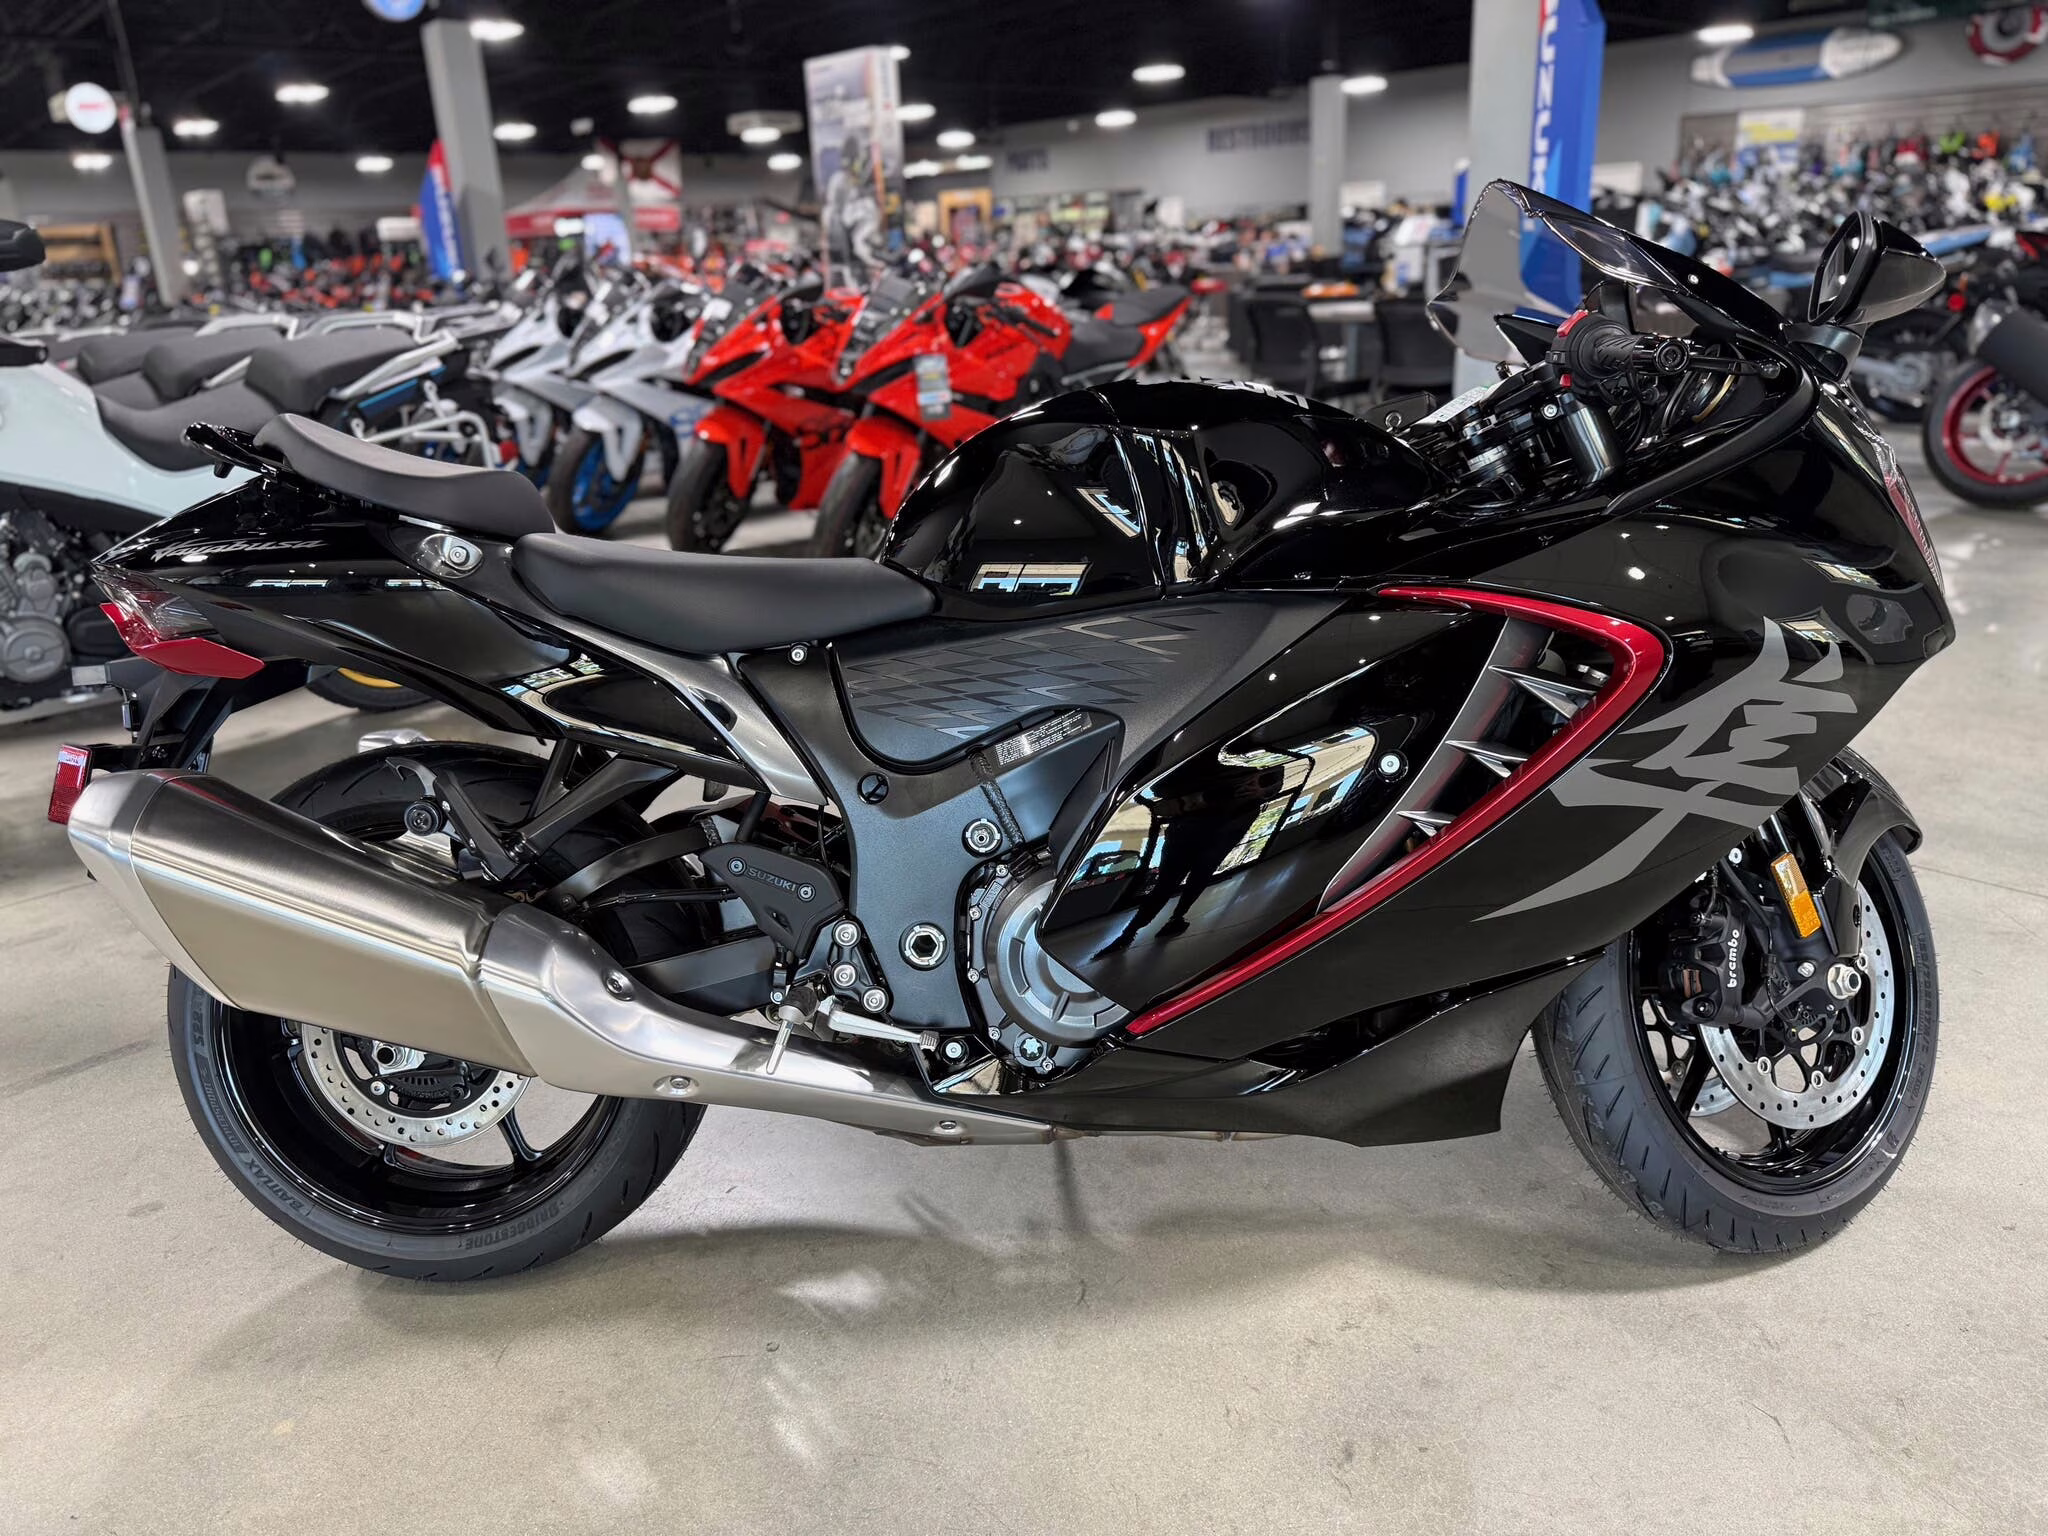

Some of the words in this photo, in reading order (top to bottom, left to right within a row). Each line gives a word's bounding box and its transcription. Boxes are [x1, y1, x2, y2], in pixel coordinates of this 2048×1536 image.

[151, 537, 328, 562] Hayabusa
[748, 867, 797, 892] SUZUKI
[1727, 929, 1740, 988] brembo
[250, 1157, 306, 1217] BATTLAX
[465, 1202, 561, 1250] BRIDGESTONE
